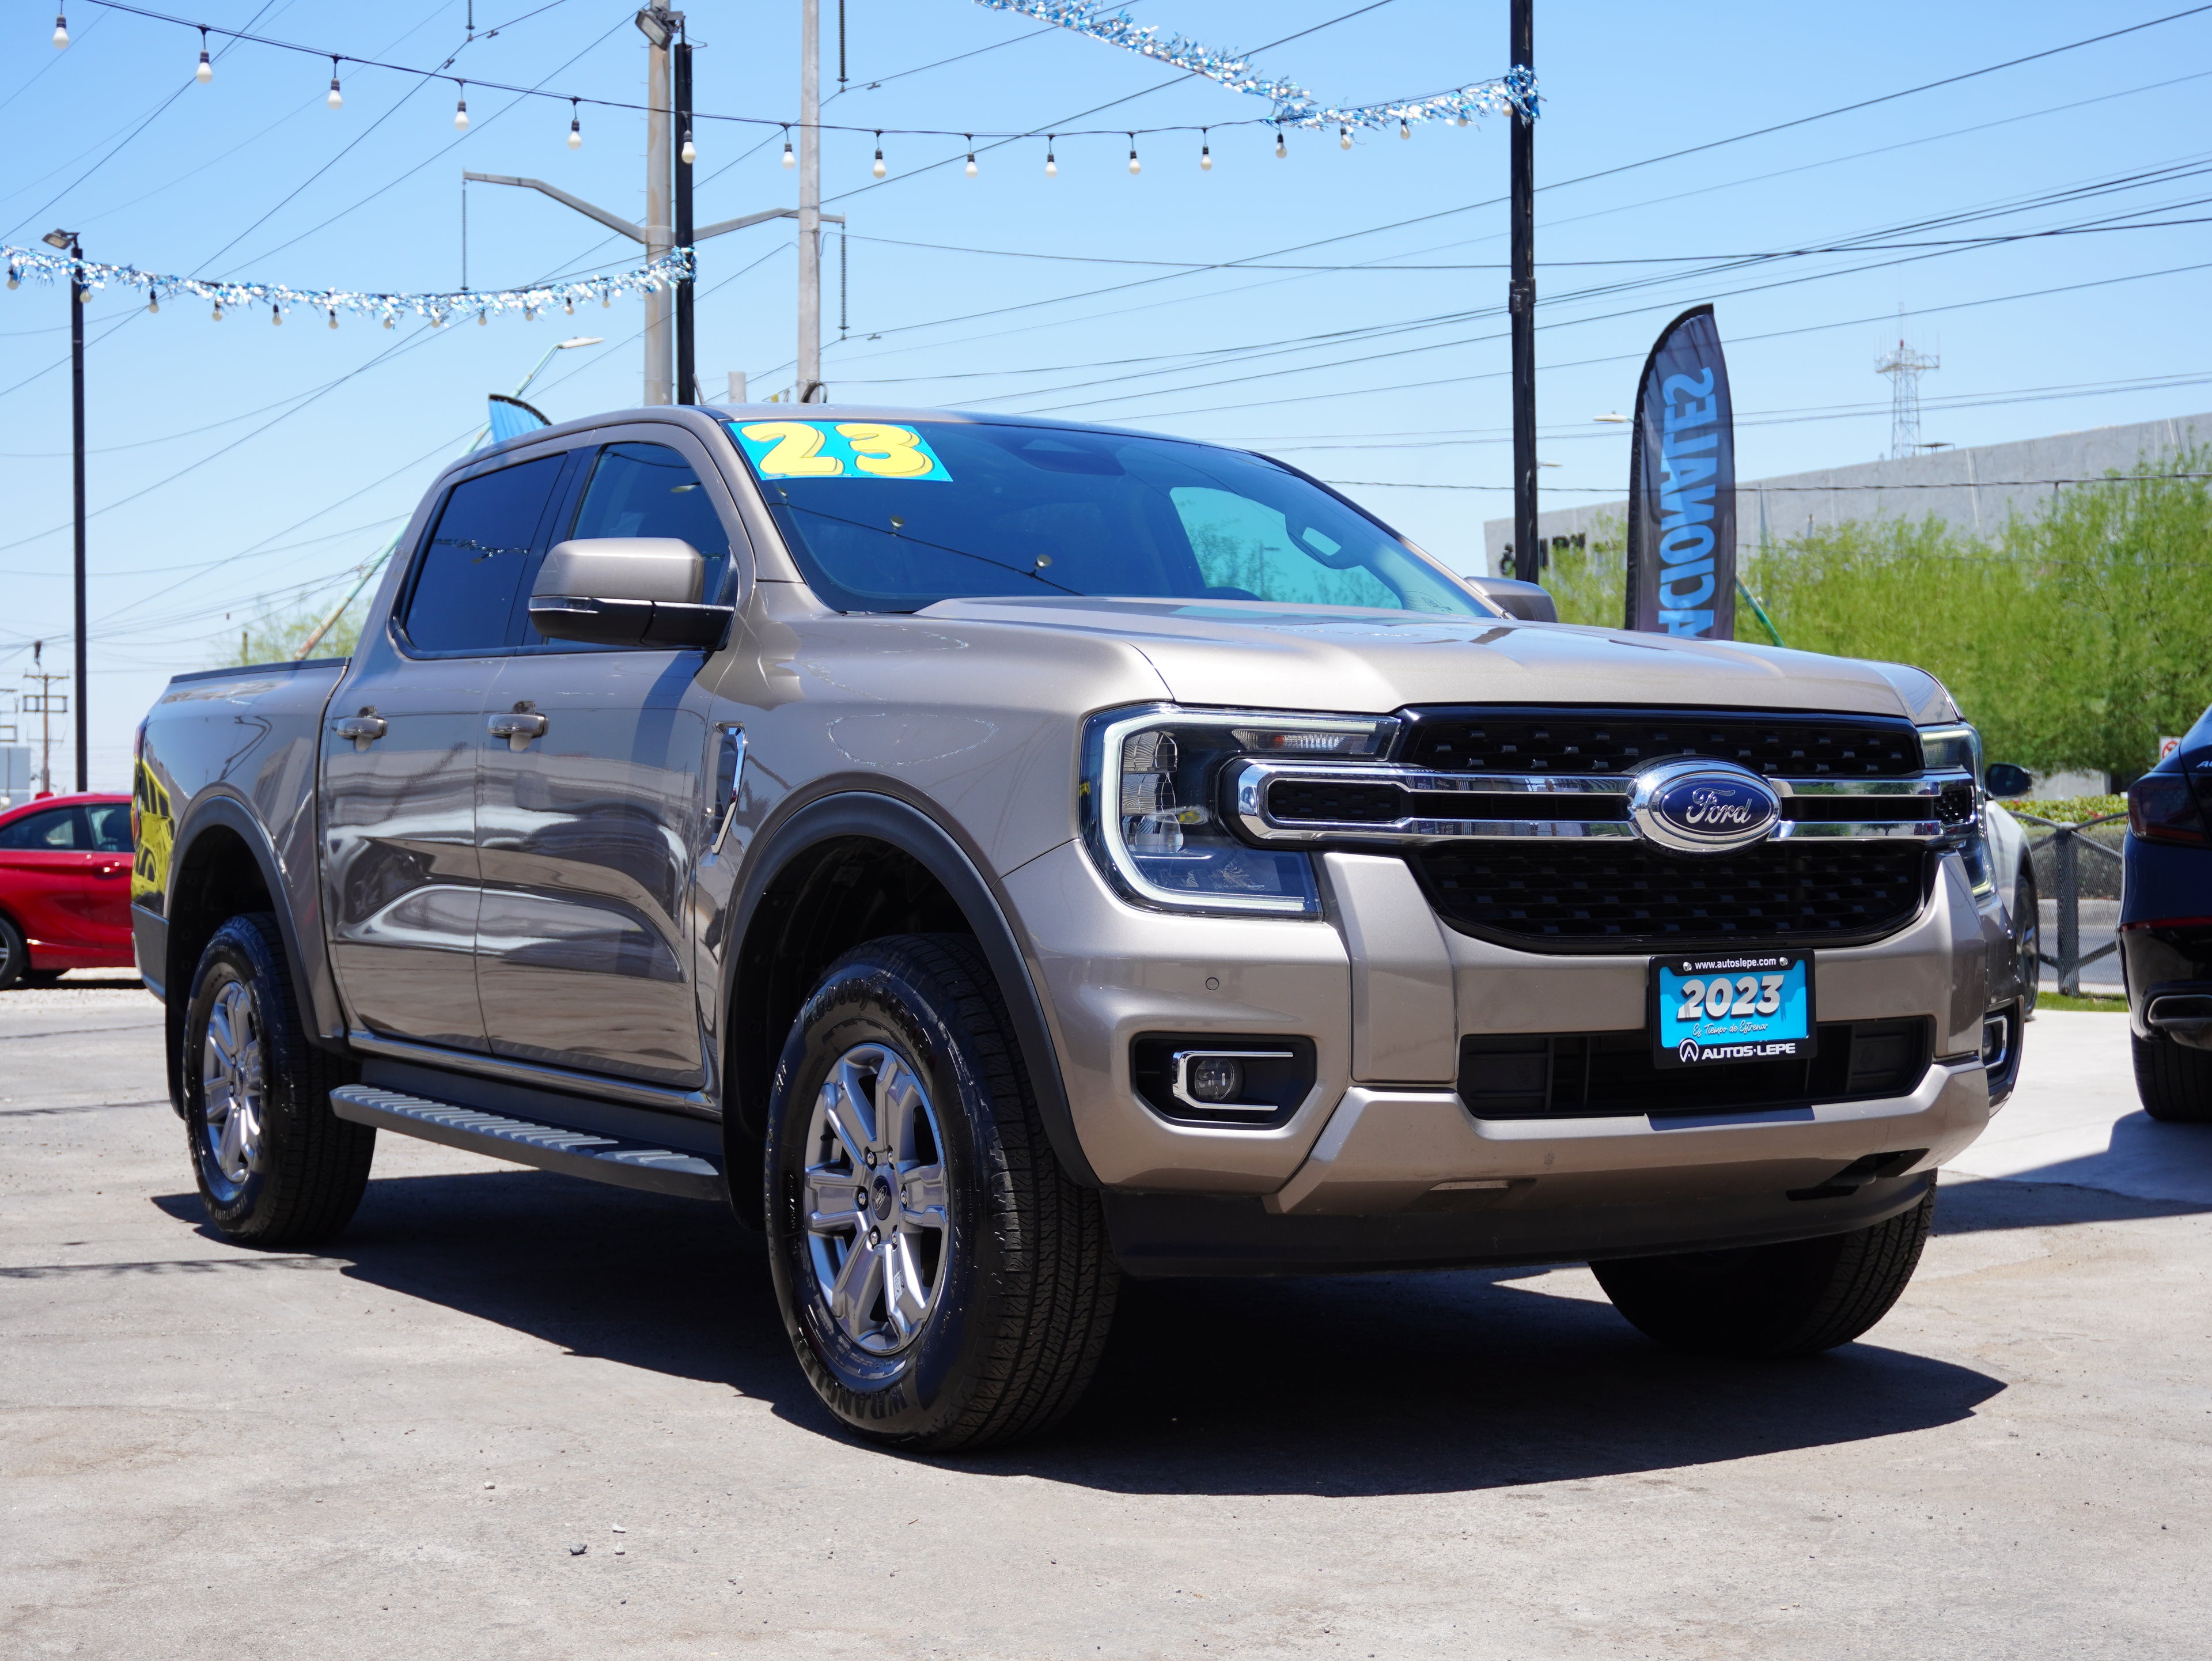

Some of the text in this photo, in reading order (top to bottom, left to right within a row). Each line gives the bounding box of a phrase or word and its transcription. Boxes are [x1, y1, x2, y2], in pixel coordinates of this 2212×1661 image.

[741, 422, 935, 477] 23
[1685, 788, 1752, 824] Ford
[1695, 958, 1777, 969] www.autoslepe.com
[1677, 974, 1784, 1019] 2023
[1692, 1019, 1768, 1037] Es Tiempo de Estrenar
